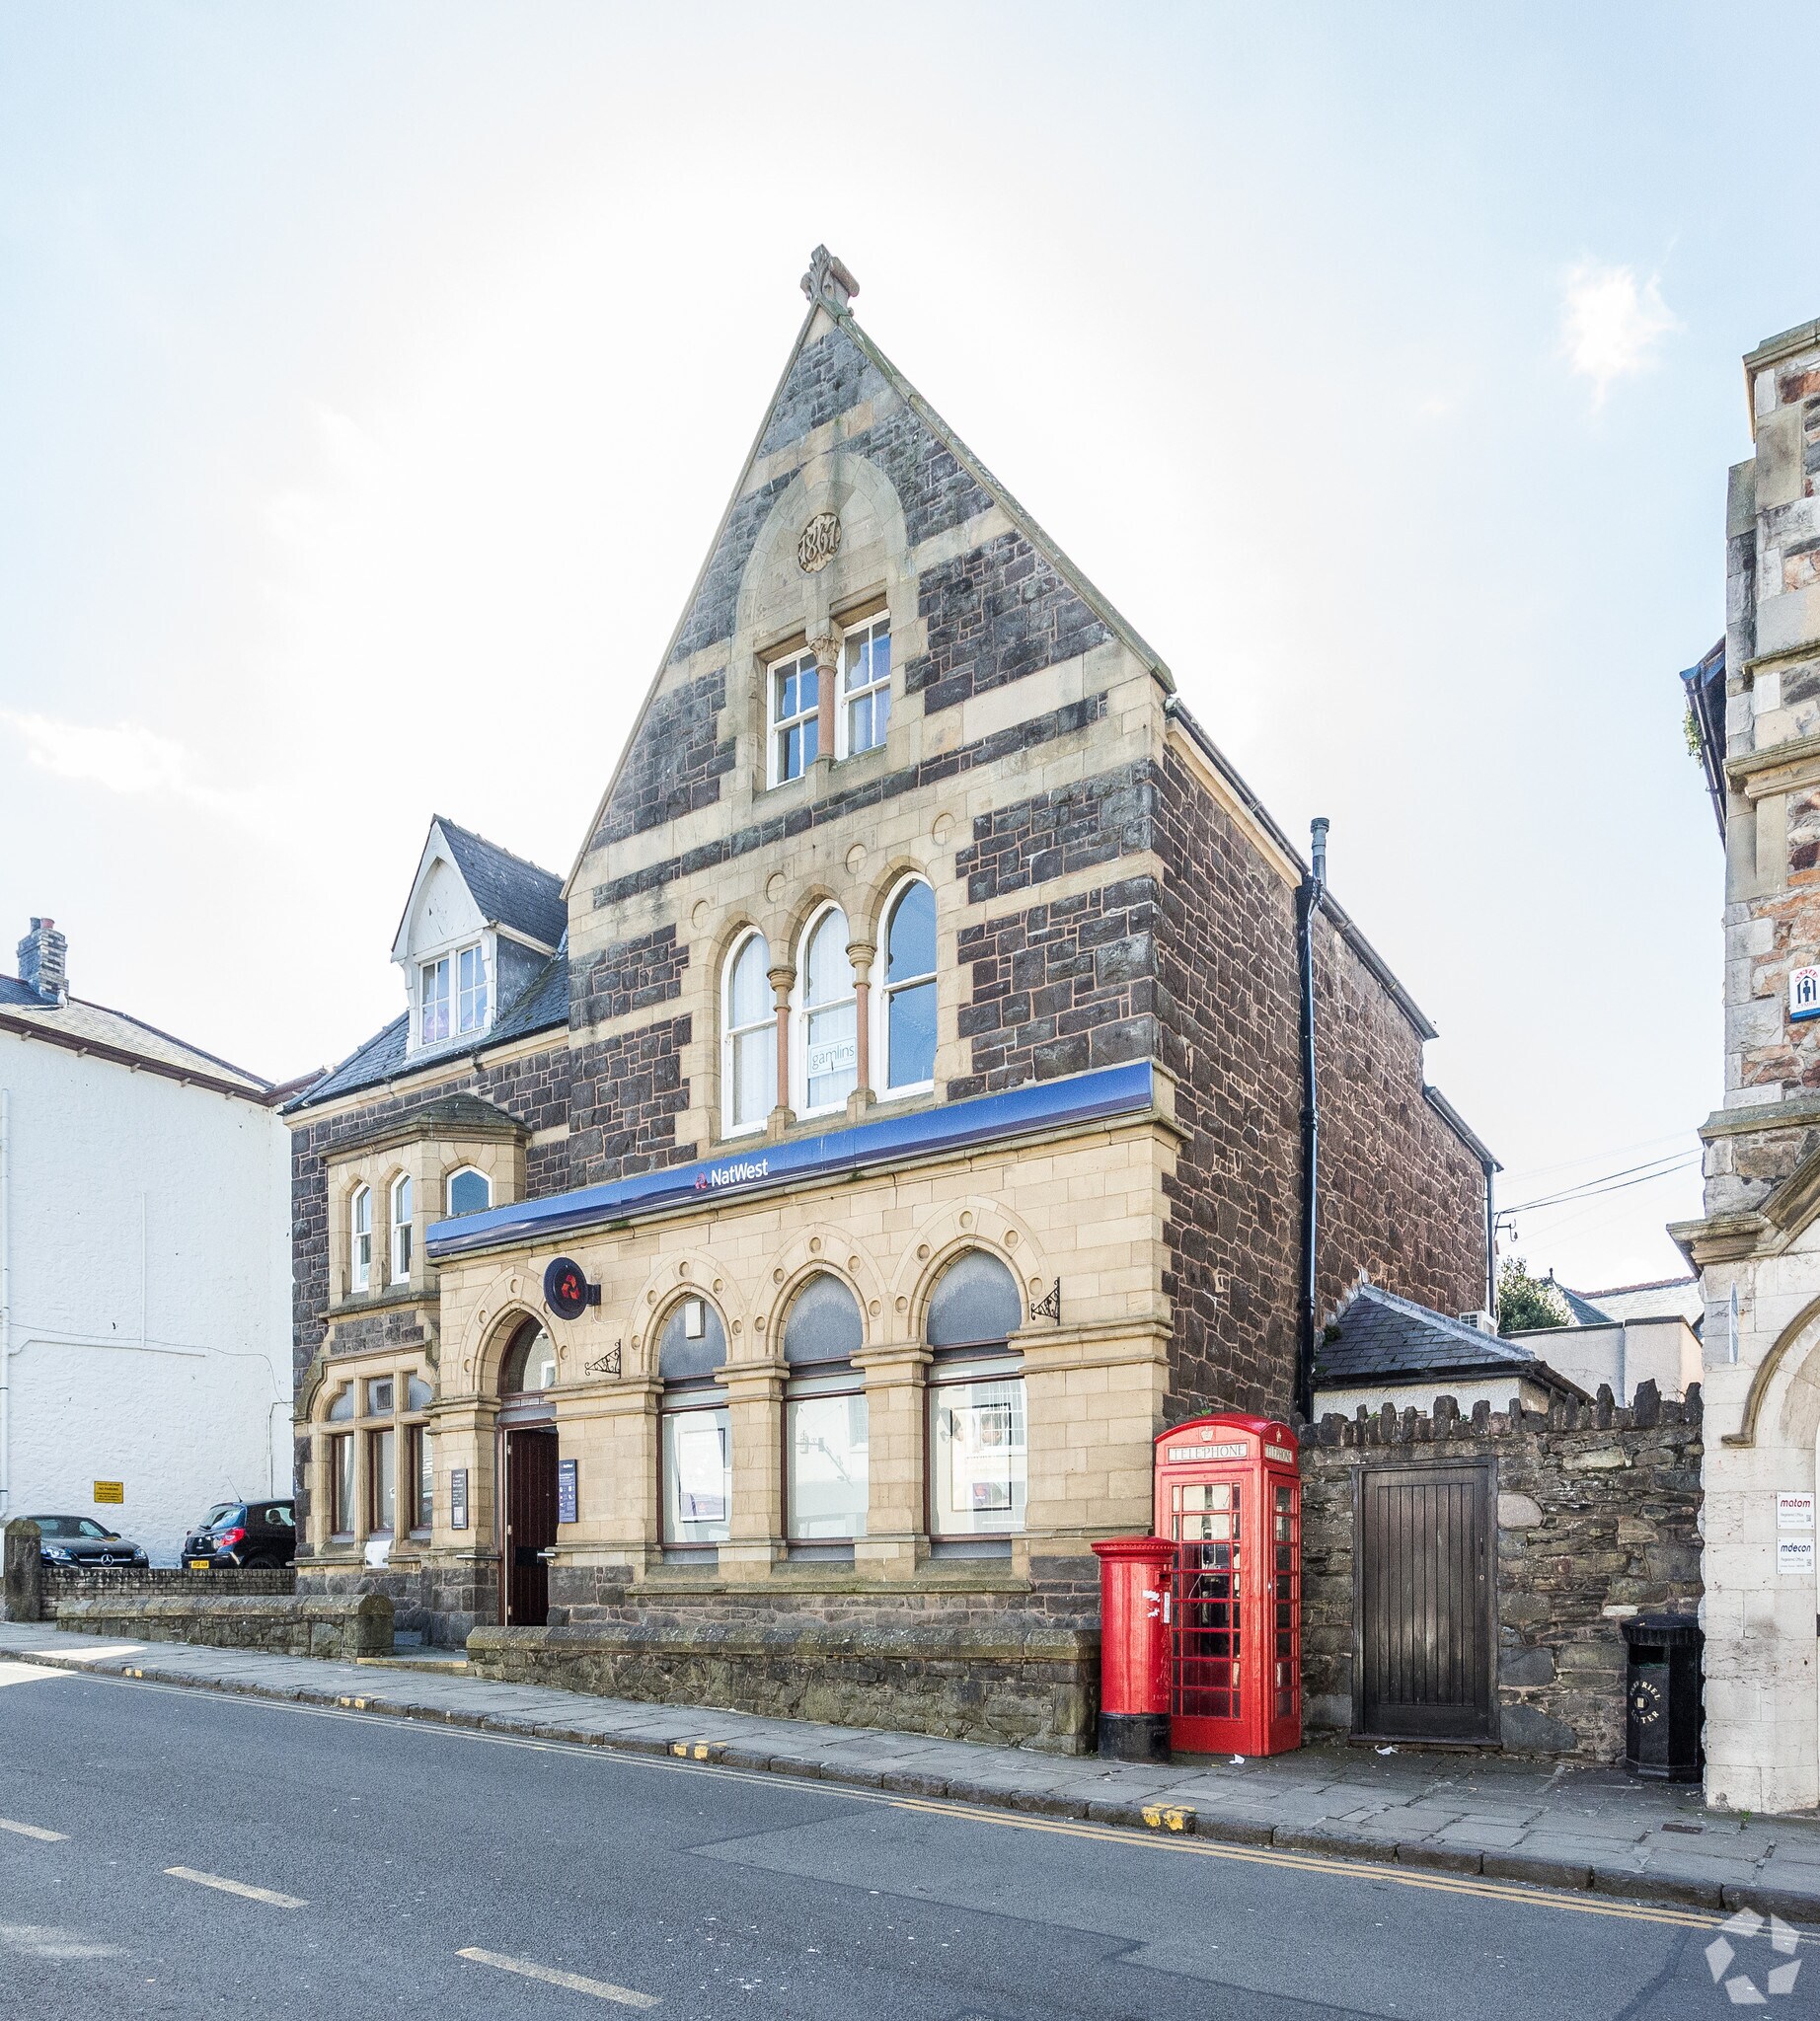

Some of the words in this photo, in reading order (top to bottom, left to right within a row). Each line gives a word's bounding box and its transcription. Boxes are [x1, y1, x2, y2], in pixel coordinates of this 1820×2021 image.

[798, 518, 837, 565] 1867
[812, 1044, 855, 1070] gamlins
[712, 1158, 769, 1187] NatWest
[1173, 1444, 1245, 1460] TELEPHONE
[1265, 1445, 1292, 1462] TELEPHONE
[1781, 1498, 1811, 1508] matom
[1781, 1542, 1811, 1552] mdecon
